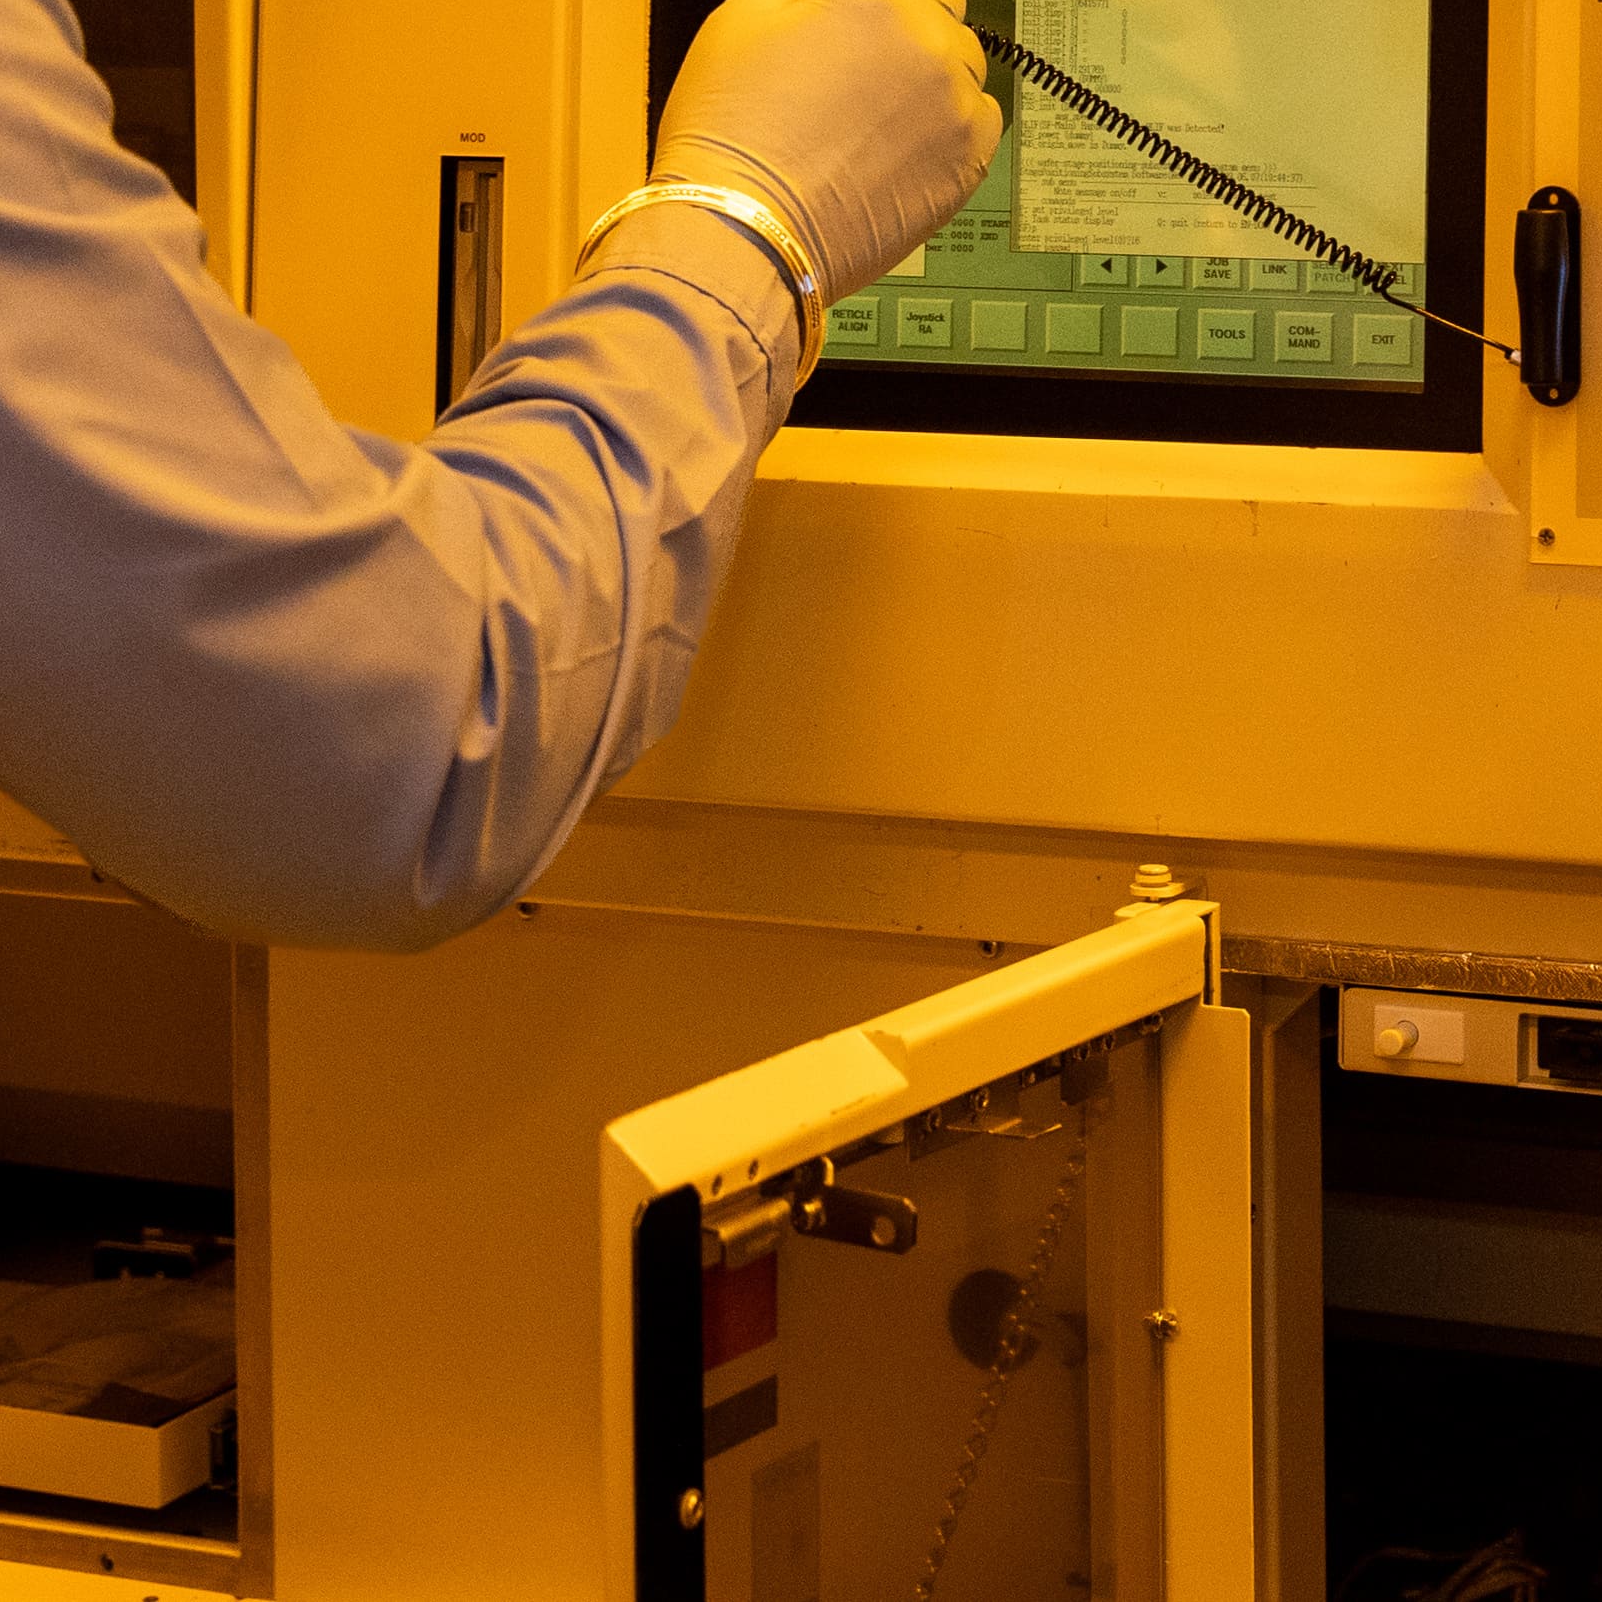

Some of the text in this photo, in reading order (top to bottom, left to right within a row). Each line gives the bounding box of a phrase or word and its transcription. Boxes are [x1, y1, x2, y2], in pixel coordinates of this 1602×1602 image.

[460, 133, 485, 142] MOD
[1204, 270, 1231, 279] SAVE
[1262, 266, 1286, 274] LINK
[833, 310, 873, 319] RETICLE
[906, 313, 944, 322] Joystick
[838, 322, 868, 332] ALIGN
[919, 325, 932, 334] RA
[1289, 326, 1320, 336] COM-
[1208, 329, 1245, 339] TOOLS
[1289, 339, 1320, 349] MAND
[1372, 335, 1395, 344] EXIT
